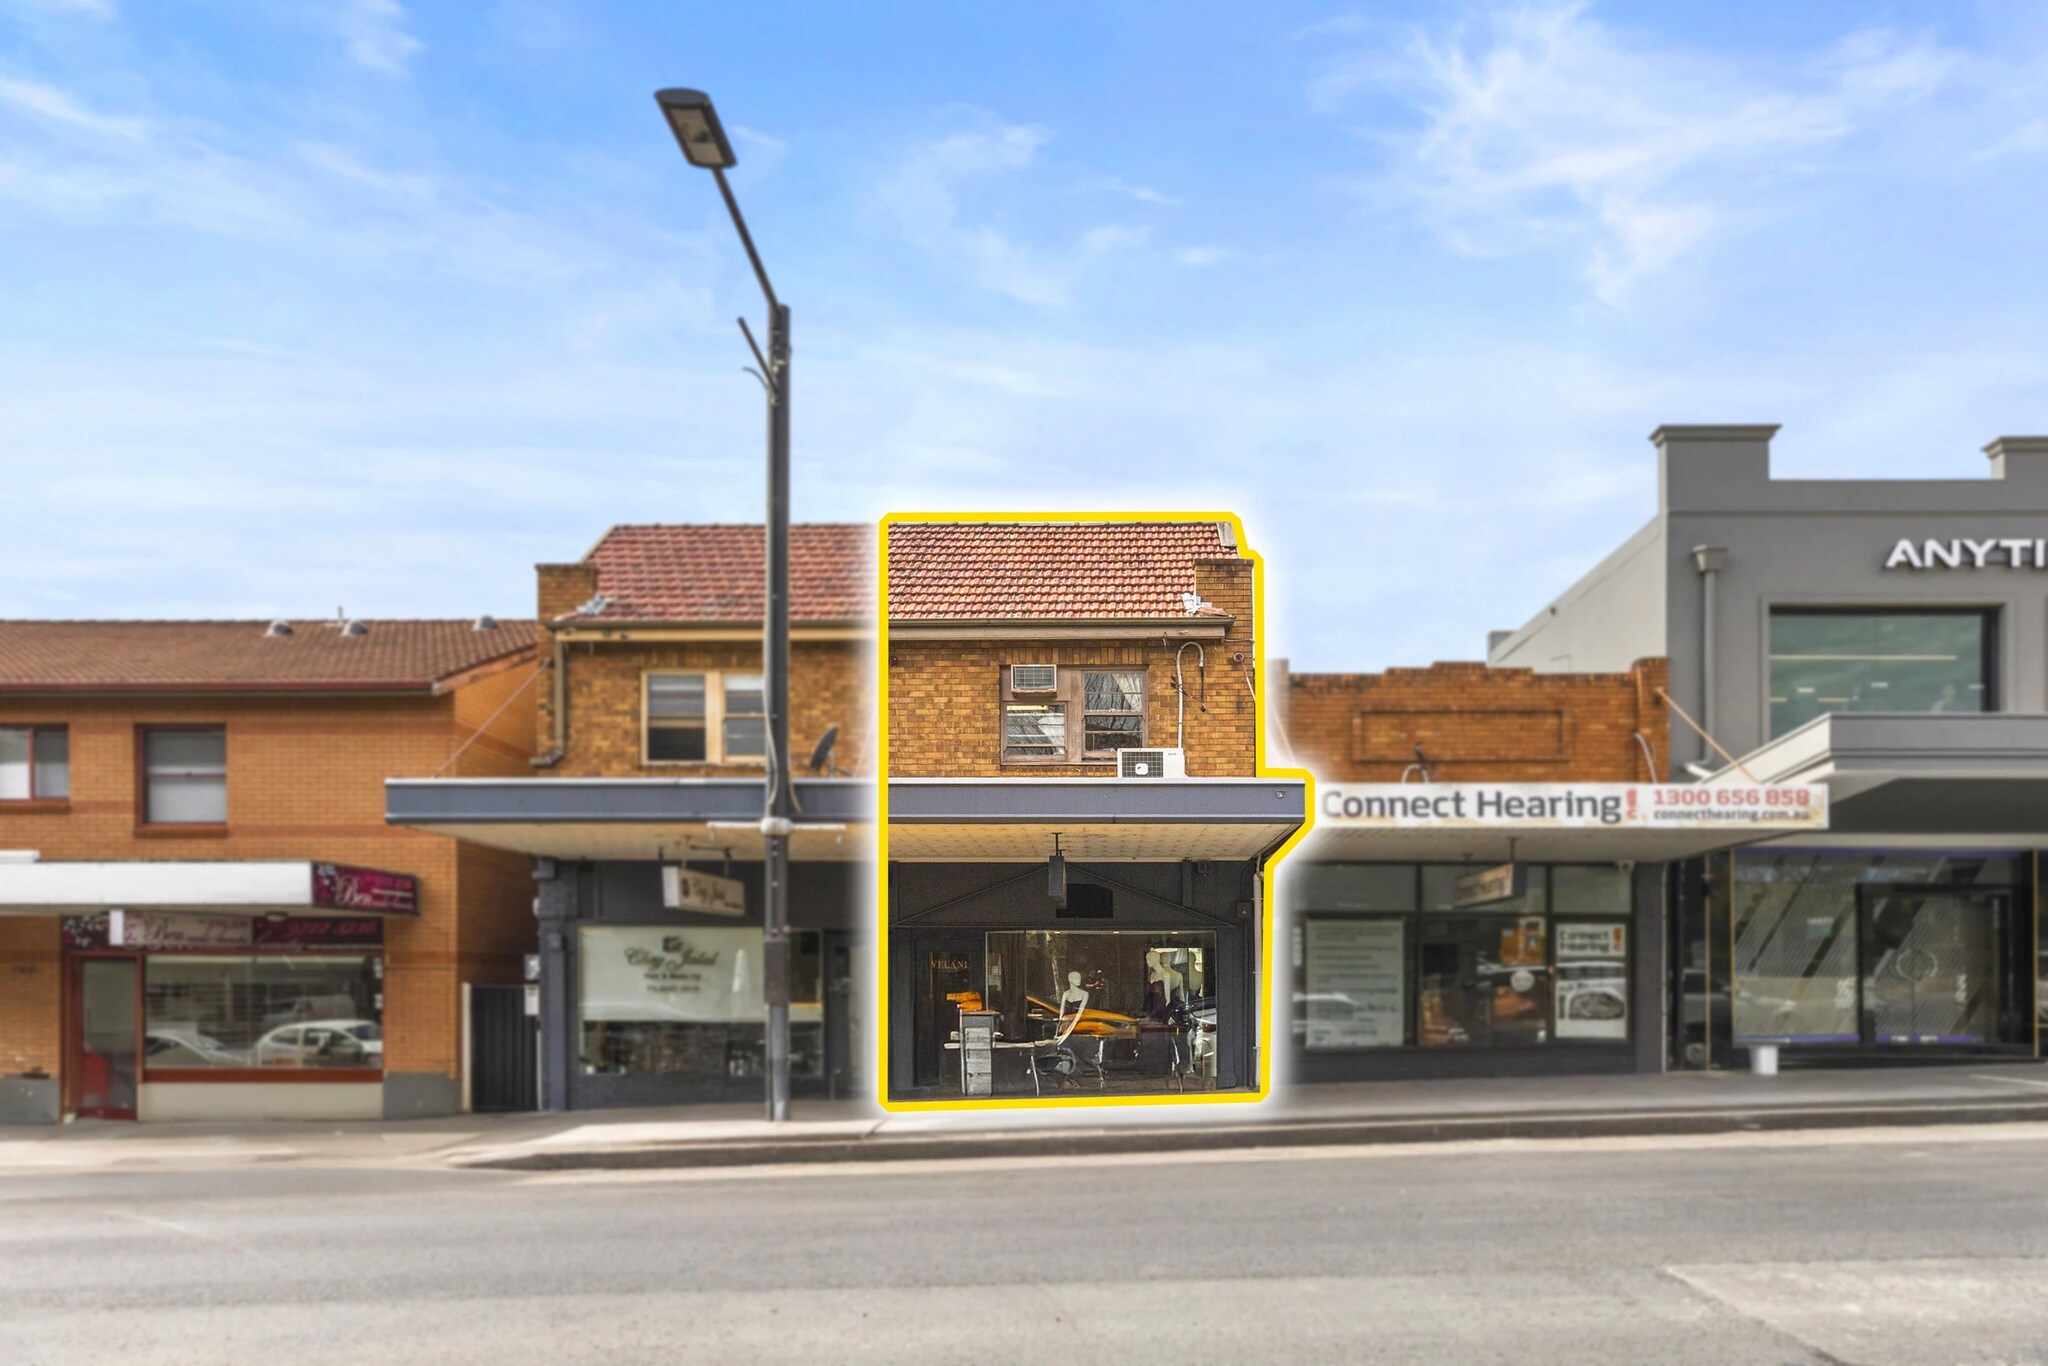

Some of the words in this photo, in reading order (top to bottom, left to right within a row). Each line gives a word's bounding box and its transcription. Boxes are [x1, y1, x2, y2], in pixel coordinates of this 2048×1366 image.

[1885, 538, 2046, 568] ANYTI
[1322, 790, 1466, 818] Connect
[1477, 790, 1621, 824] Hearing
[1654, 788, 1711, 806] 1300
[1716, 788, 1760, 806] 656
[1765, 788, 1810, 806] 858
[1653, 808, 1810, 823] connecthearing.com.au
